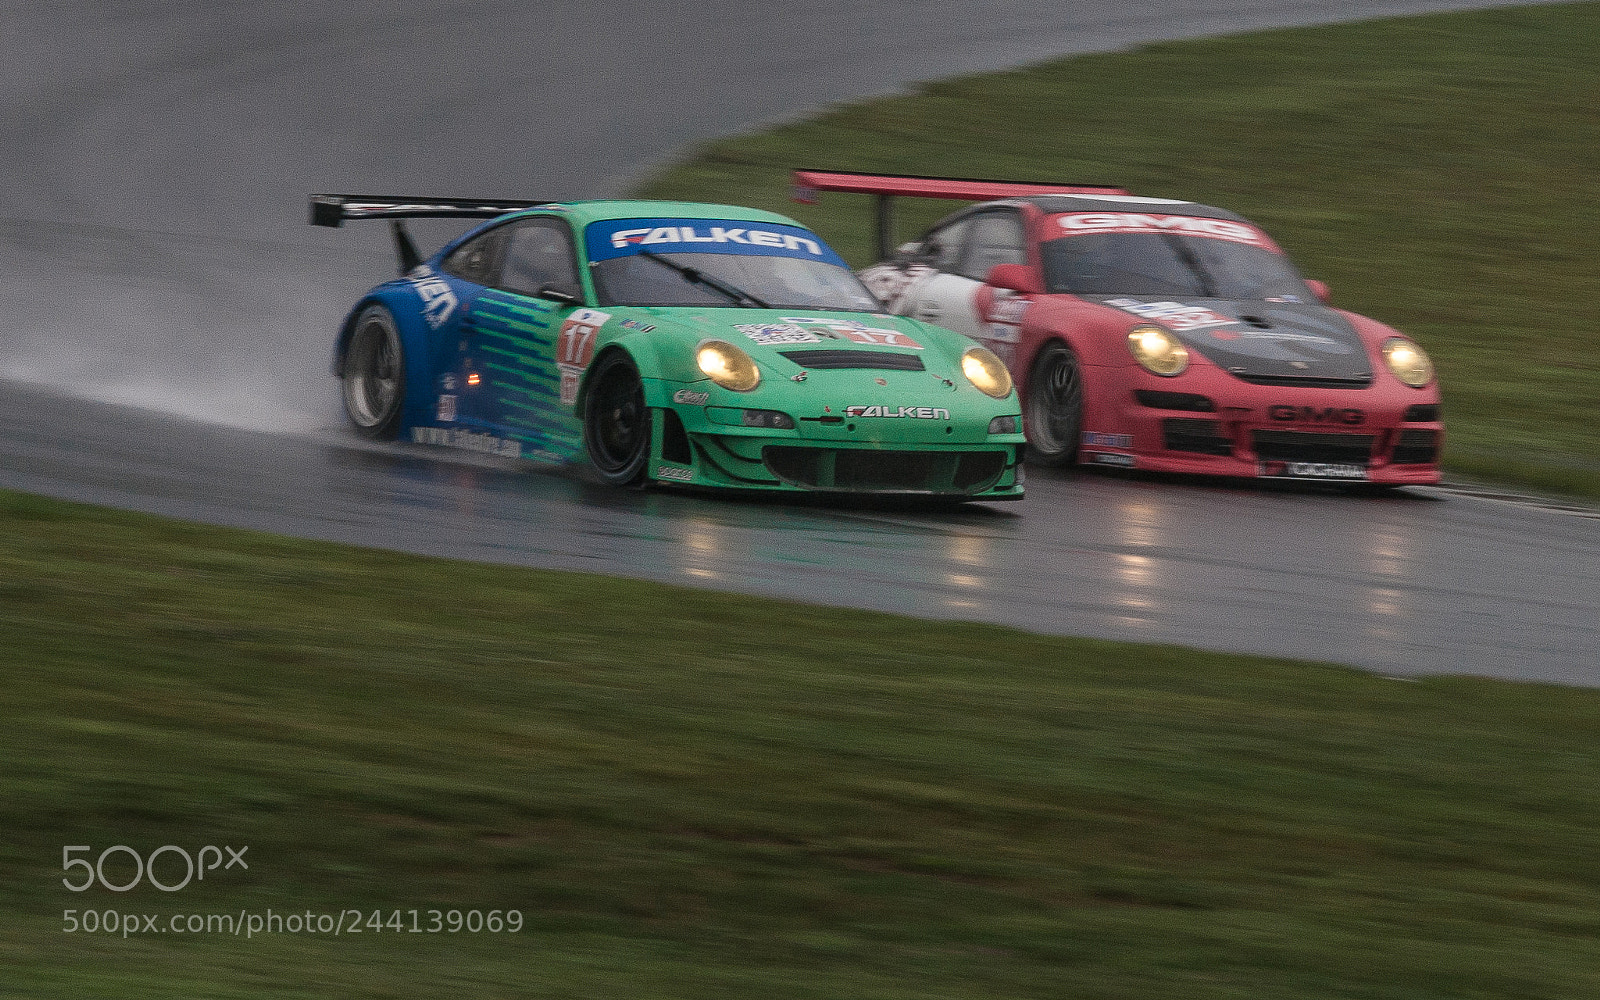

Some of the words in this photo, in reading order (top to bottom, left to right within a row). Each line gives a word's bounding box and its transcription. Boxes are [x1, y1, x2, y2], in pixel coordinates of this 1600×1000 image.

[612, 227, 823, 255] FALKEN
[564, 324, 594, 364] 17
[851, 331, 898, 345] 17
[846, 405, 951, 420] FALKEN
[1268, 405, 1365, 425] GMG
